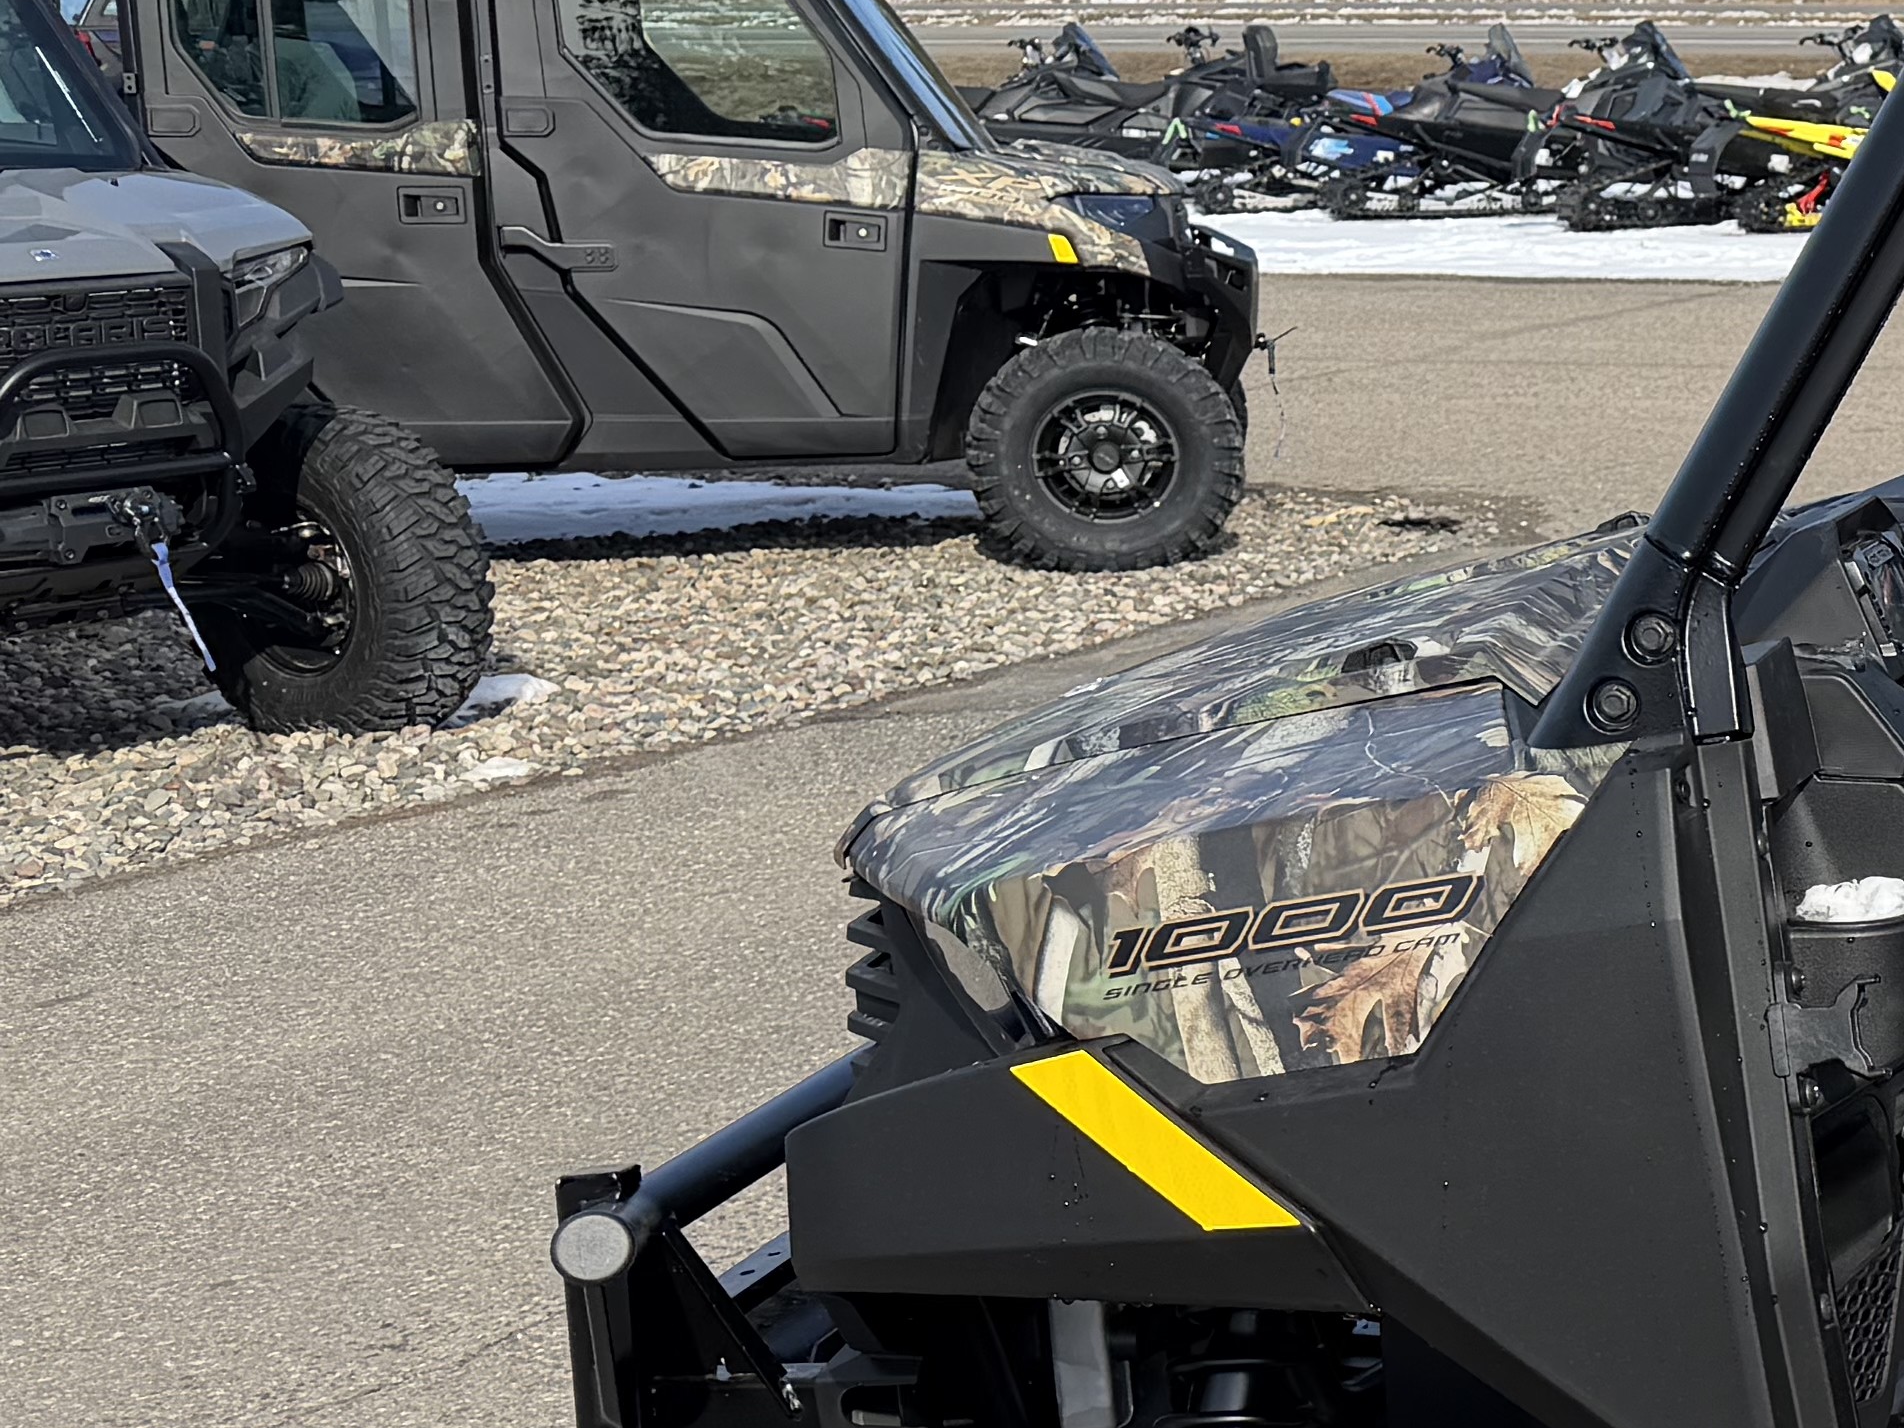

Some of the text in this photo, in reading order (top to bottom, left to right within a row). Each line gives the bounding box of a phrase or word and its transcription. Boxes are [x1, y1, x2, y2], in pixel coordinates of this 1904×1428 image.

[1103, 932, 1460, 1001] SINGLE OVERHEAD CAM
[1107, 872, 1484, 978] 1000
